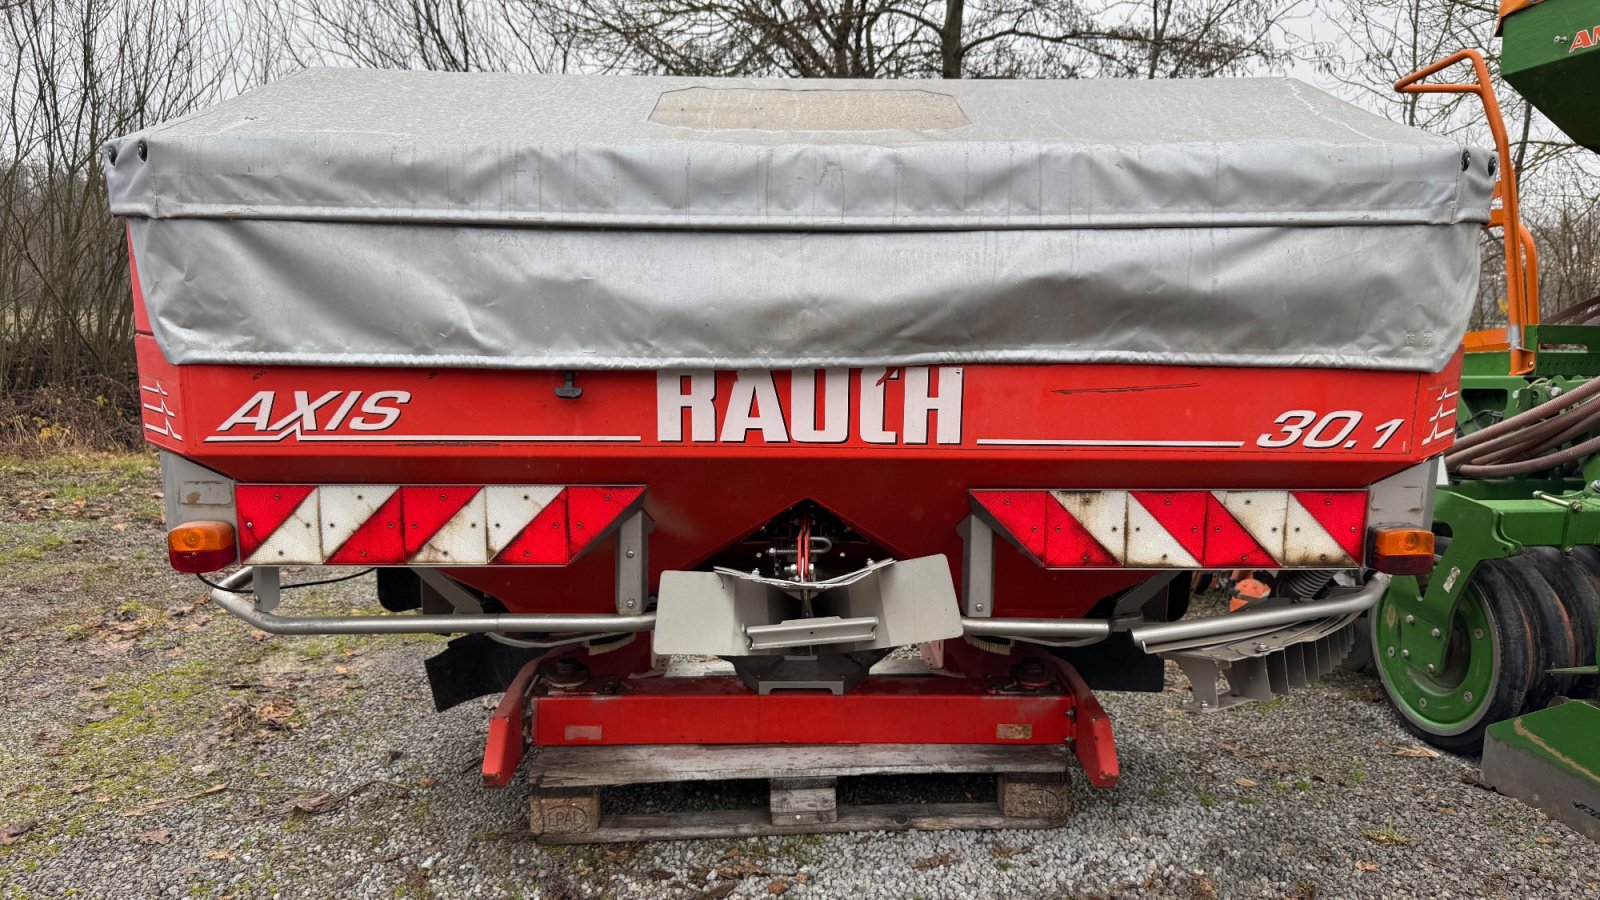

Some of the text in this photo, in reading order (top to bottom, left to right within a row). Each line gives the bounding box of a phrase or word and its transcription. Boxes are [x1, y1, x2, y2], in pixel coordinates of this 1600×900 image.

[216, 391, 412, 431] AXIS
[656, 367, 963, 445] RAUCH
[1256, 410, 1404, 449] 30.1
[548, 811, 582, 828] EPAL
